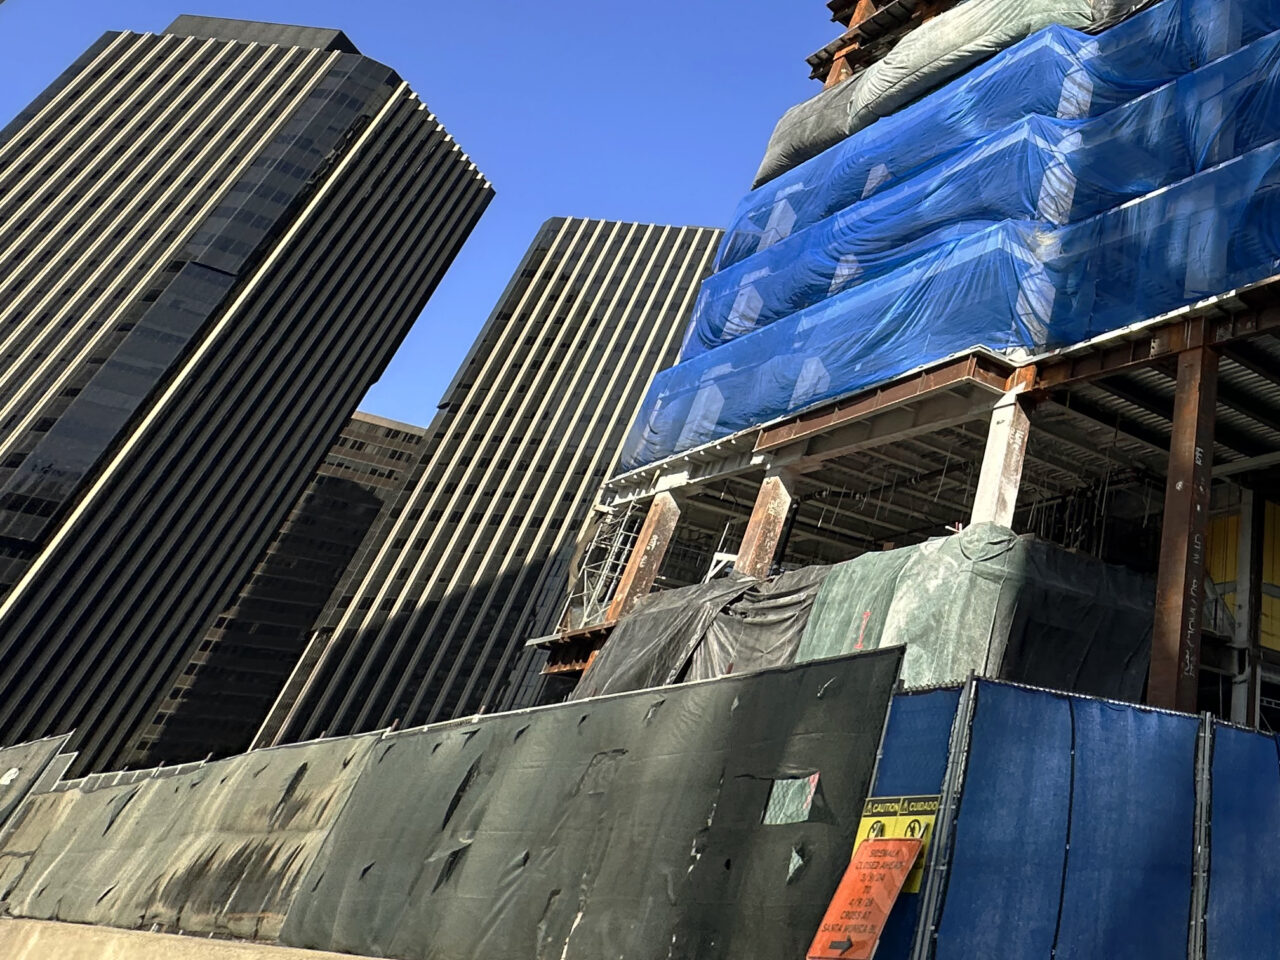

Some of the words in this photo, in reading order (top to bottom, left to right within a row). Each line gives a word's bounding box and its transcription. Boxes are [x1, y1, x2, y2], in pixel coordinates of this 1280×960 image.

[872, 802, 900, 813] CAUTION
[909, 801, 938, 811] CUIDADO
[856, 861, 880, 870] CLOSED
[880, 861, 905, 870] AHEAD
[840, 911, 861, 920] CROSS
[862, 911, 873, 920] AT
[821, 923, 843, 932] SANTA
